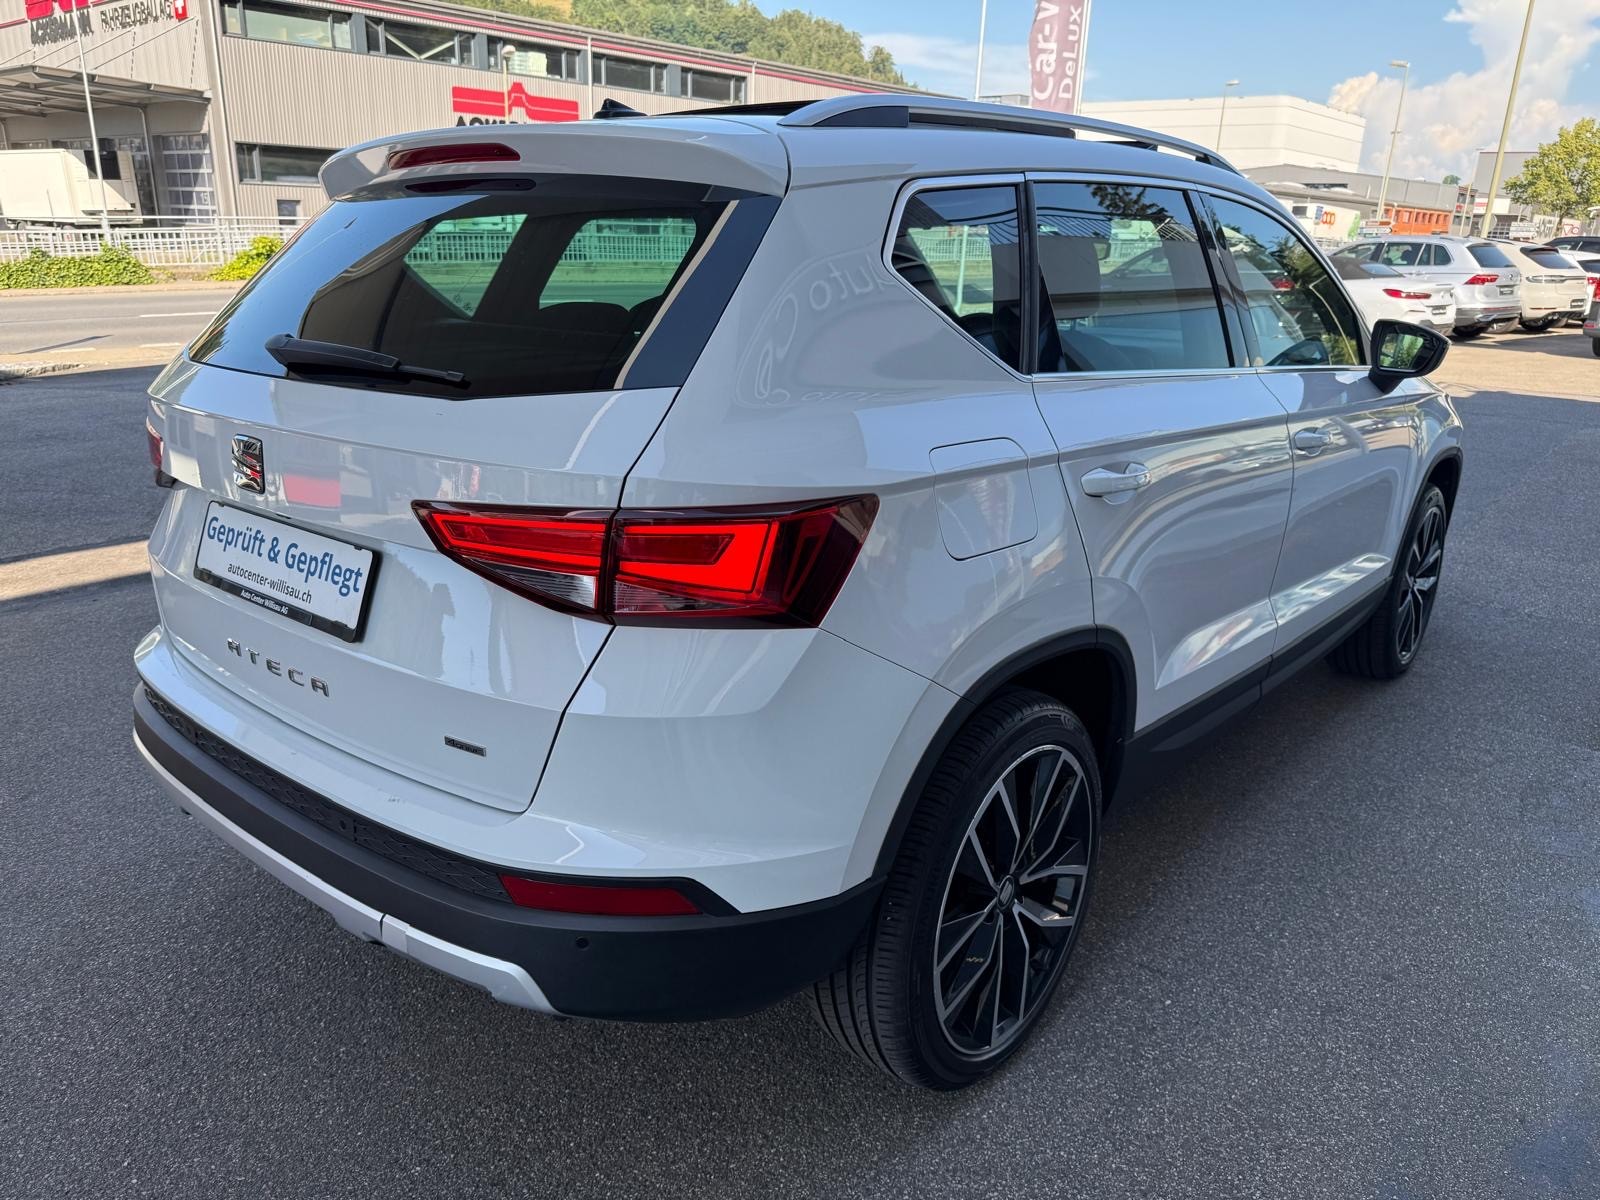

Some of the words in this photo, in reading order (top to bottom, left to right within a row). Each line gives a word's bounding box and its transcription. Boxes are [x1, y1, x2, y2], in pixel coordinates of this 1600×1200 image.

[1058, 5, 1082, 99] DeLux
[207, 516, 265, 557] Geprüft
[267, 536, 281, 564] &
[284, 542, 363, 598] Gepflegt
[227, 562, 313, 605] autocenter-willisau.ch
[240, 590, 252, 599] Auto
[251, 593, 265, 605] Center
[264, 598, 281, 612] Willisau
[281, 605, 289, 615] AG
[226, 638, 330, 698] ATECA
